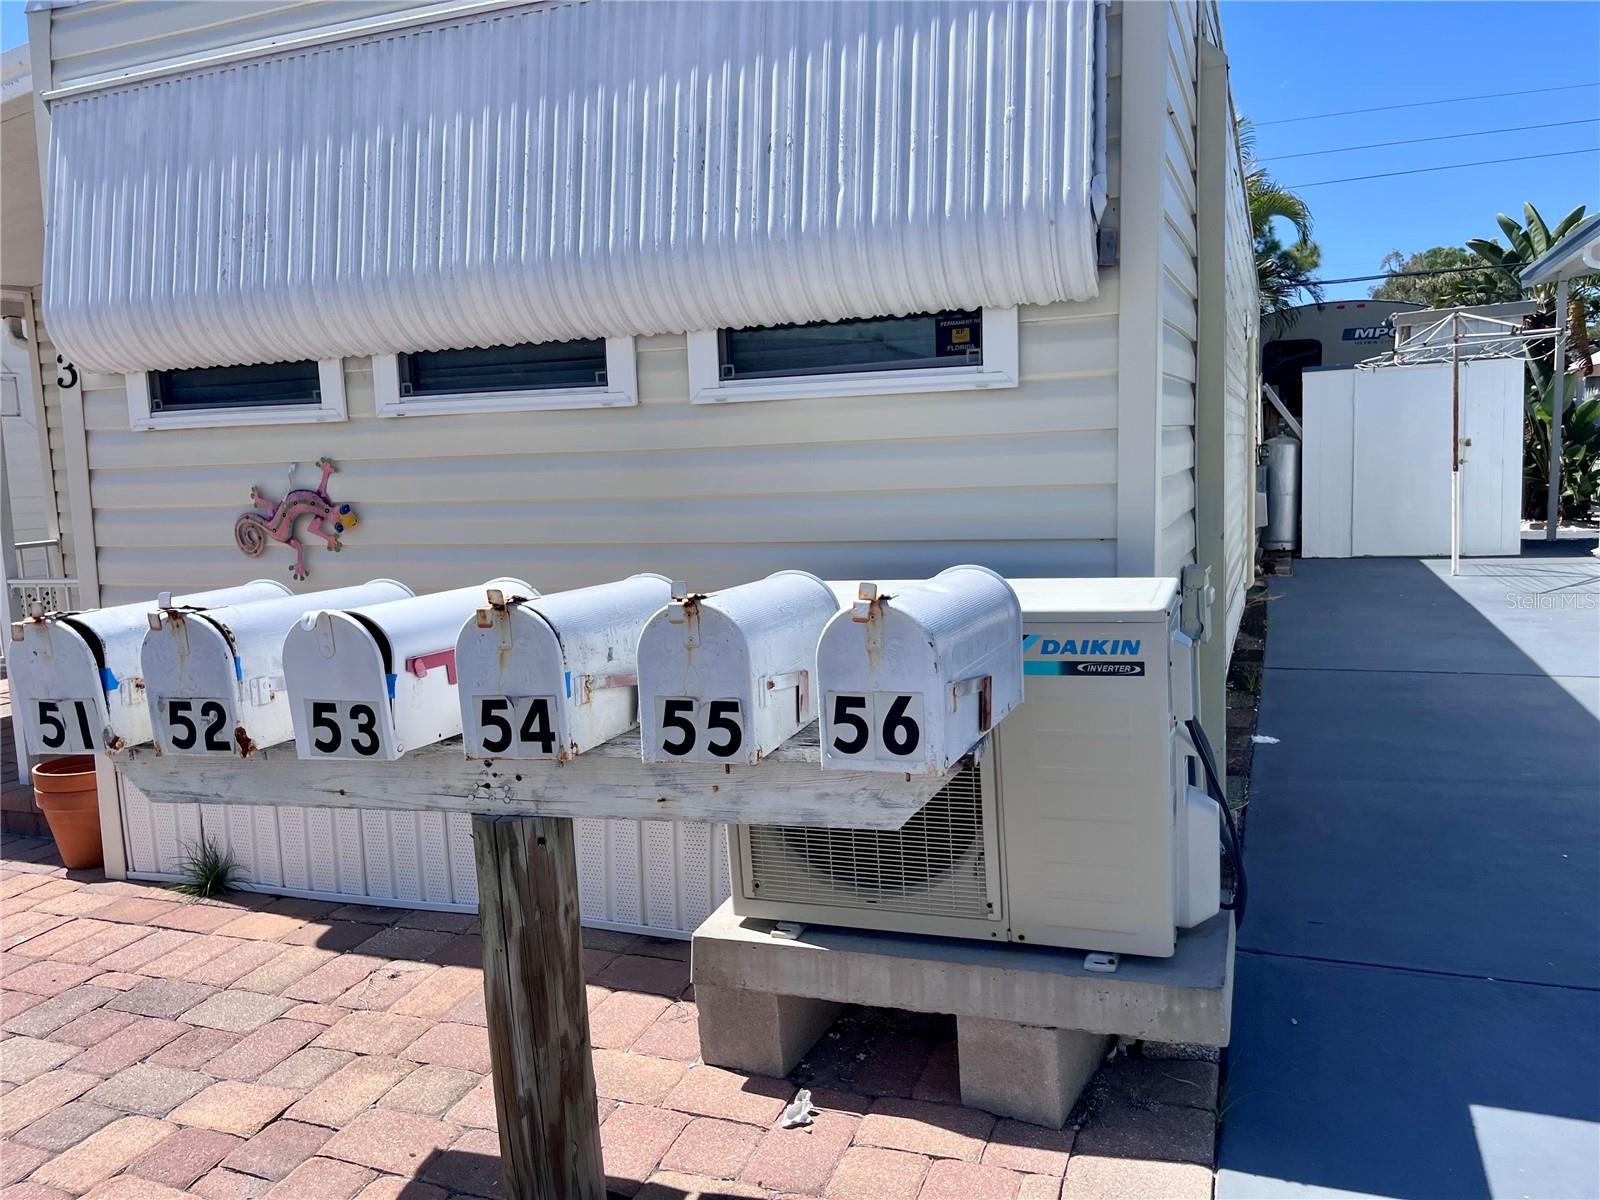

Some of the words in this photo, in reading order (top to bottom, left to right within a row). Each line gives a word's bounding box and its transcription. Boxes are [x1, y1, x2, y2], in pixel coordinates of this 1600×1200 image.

[57, 354, 78, 389] 3
[946, 344, 976, 352] FLORIDA
[1040, 639, 1141, 655] DAIKIN
[1086, 664, 1132, 673] INVERTER
[39, 701, 95, 750] 51
[169, 700, 232, 752] 52
[312, 701, 380, 756] 53
[481, 698, 556, 754] 54
[662, 699, 742, 758] 55
[833, 695, 920, 756] 56
